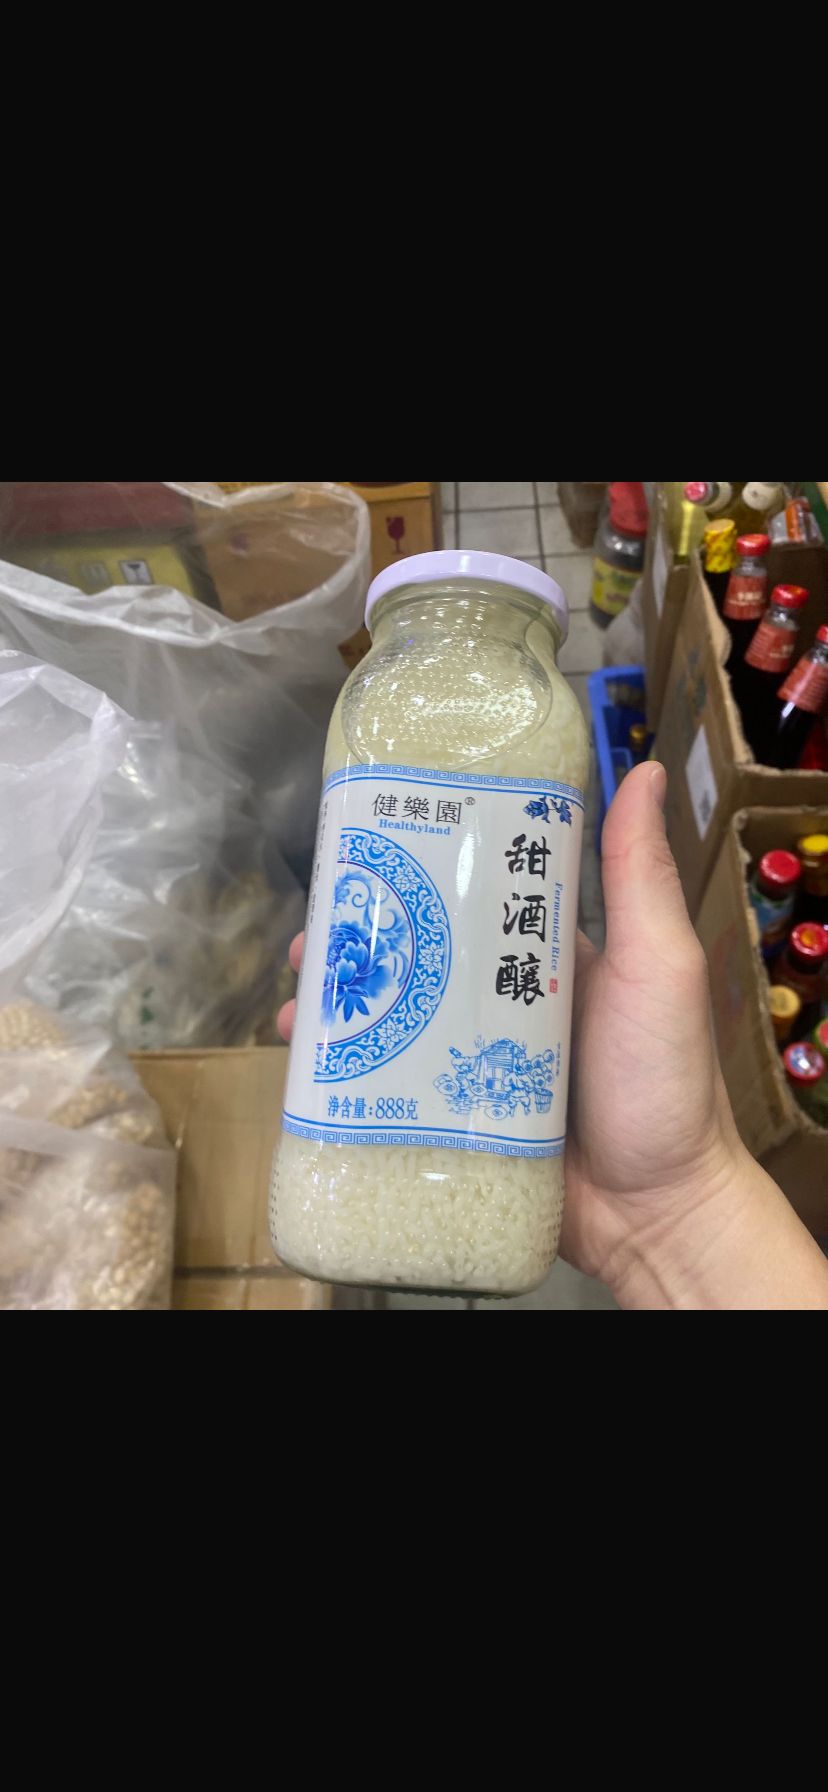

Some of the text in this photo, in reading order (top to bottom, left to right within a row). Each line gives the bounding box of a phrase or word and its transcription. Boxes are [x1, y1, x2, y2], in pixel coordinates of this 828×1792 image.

[378, 818, 452, 836] Healthyland
[552, 882, 564, 943] Fermented
[551, 945, 561, 972] Rice
[327, 1094, 419, 1121] 净含量:888克
